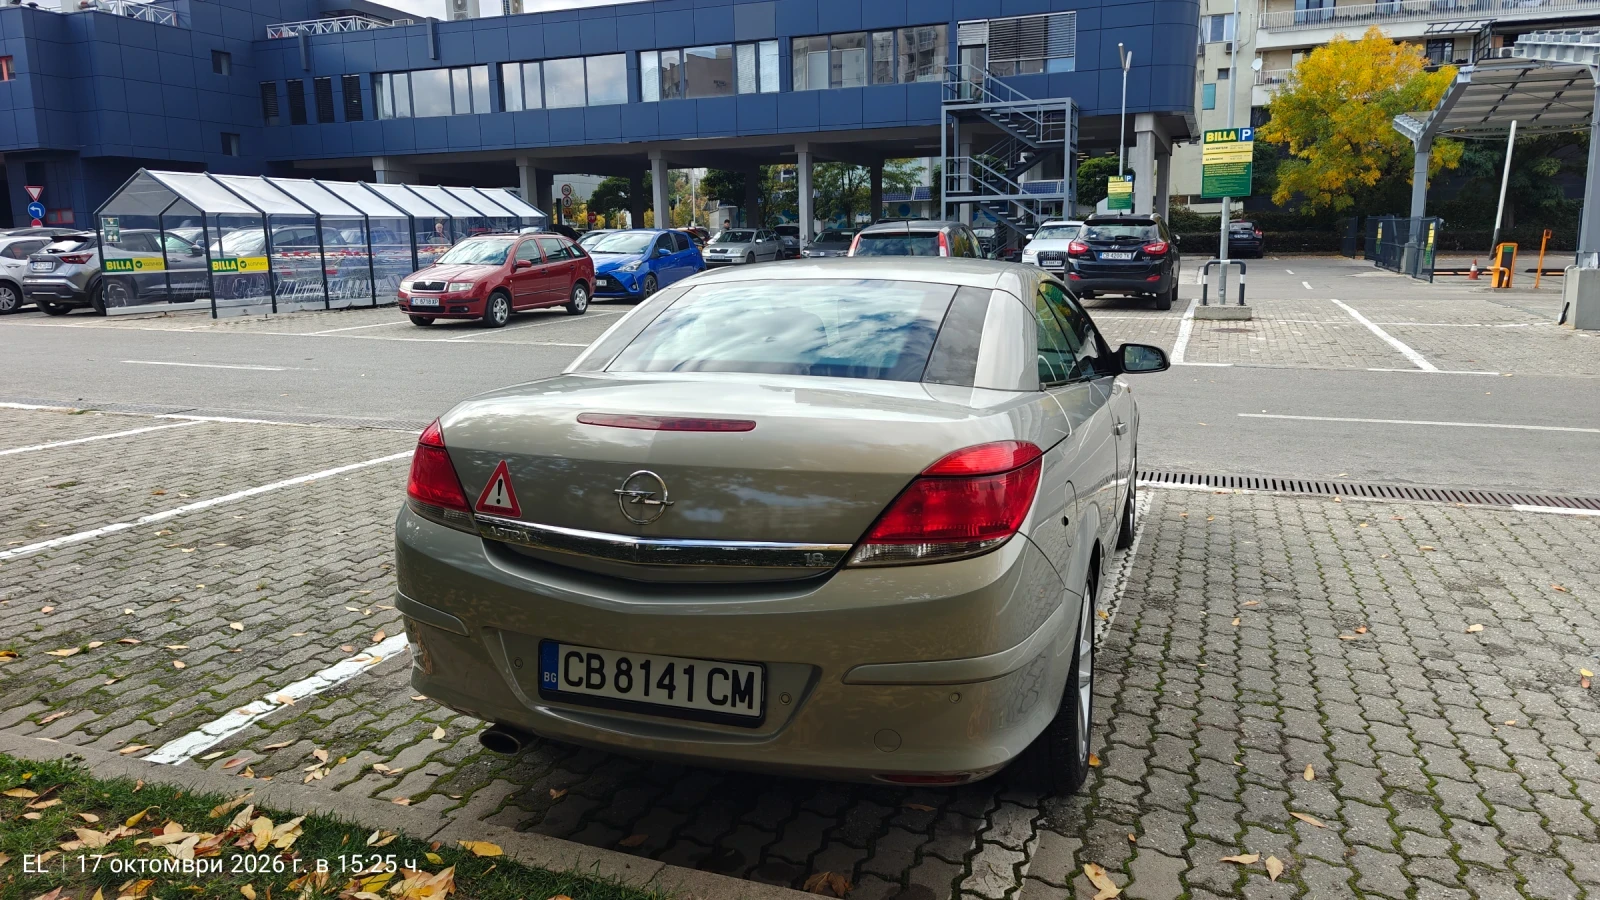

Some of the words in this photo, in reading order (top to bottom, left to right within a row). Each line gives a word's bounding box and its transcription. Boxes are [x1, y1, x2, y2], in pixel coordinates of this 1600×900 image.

[1205, 131, 1237, 142] BILLA
[1241, 129, 1251, 141] P
[106, 259, 133, 270] BILLA
[212, 260, 237, 271] BILLA
[489, 525, 530, 542] ASTRA
[543, 671, 557, 683] BG
[564, 651, 606, 690] CB
[613, 657, 695, 702] 8141
[706, 667, 755, 710] CM
